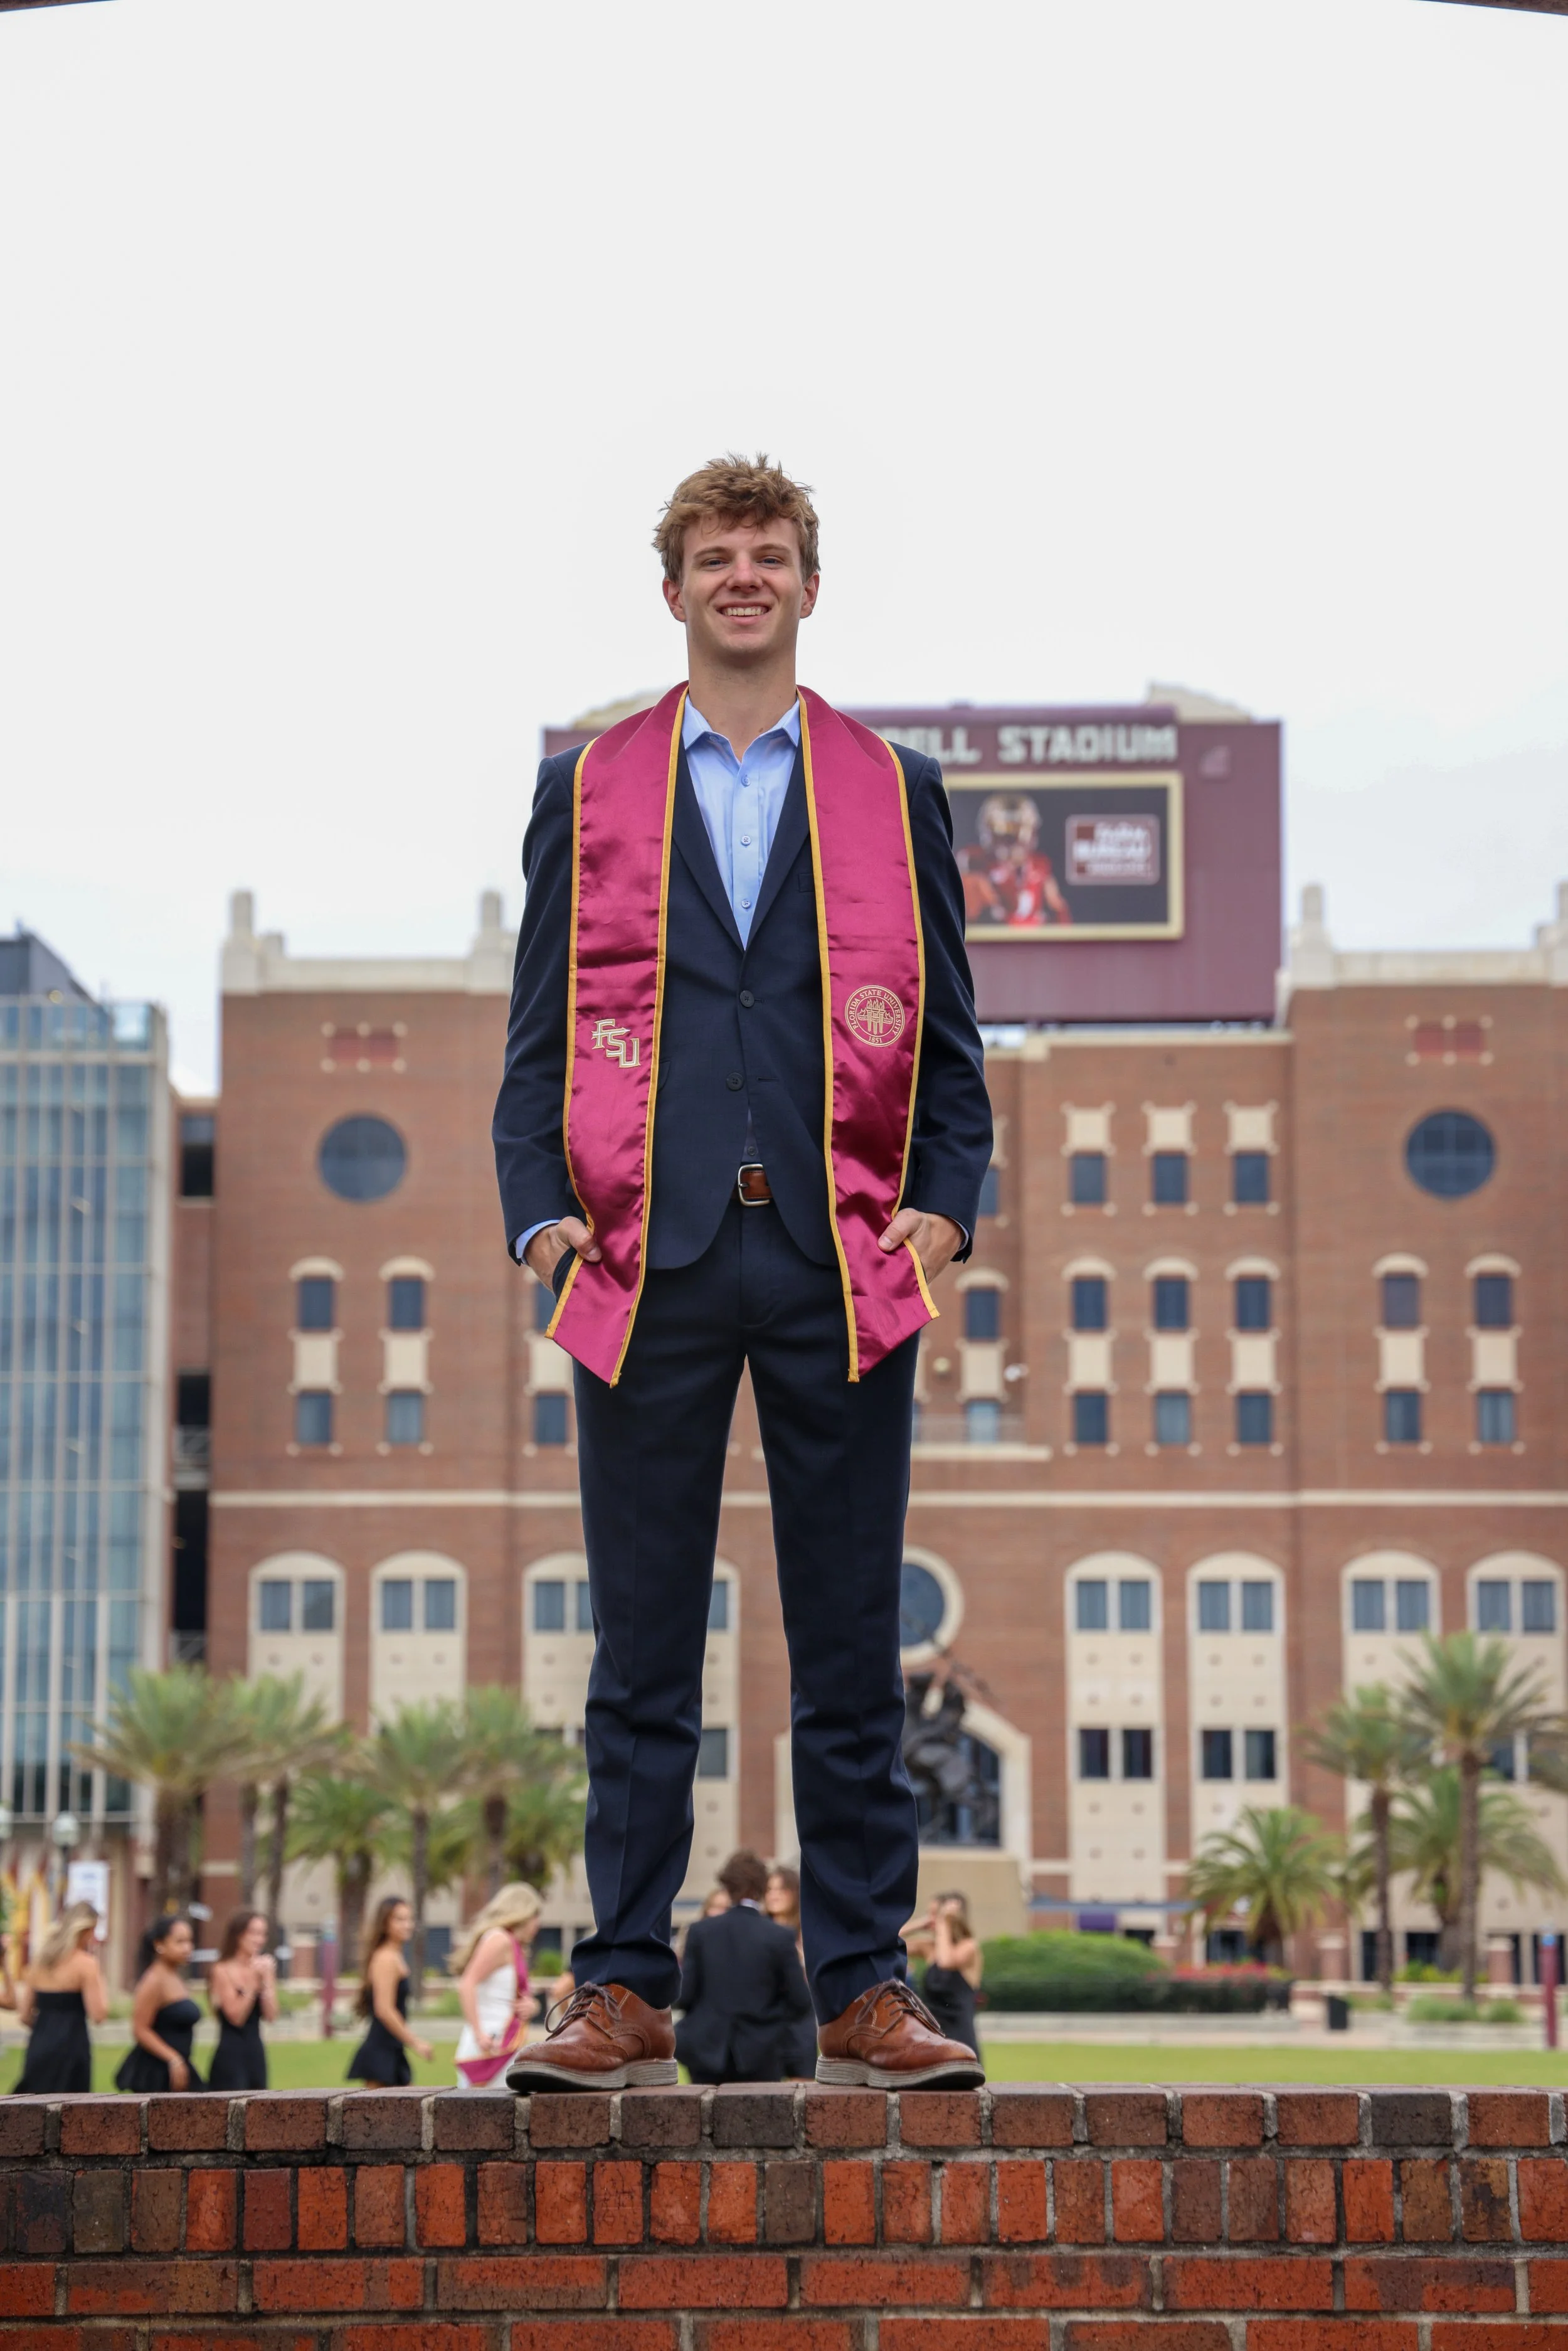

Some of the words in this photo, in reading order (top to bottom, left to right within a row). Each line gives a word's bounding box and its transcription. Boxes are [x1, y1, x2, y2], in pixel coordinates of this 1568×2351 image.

[997, 724, 1177, 764] STADIUM
[849, 998, 861, 1029] FLORIDA
[859, 989, 882, 999] STATE
[884, 993, 901, 1036] UNIVERSITY
[591, 1019, 641, 1068] FSU
[868, 1036, 882, 1044] 1851
